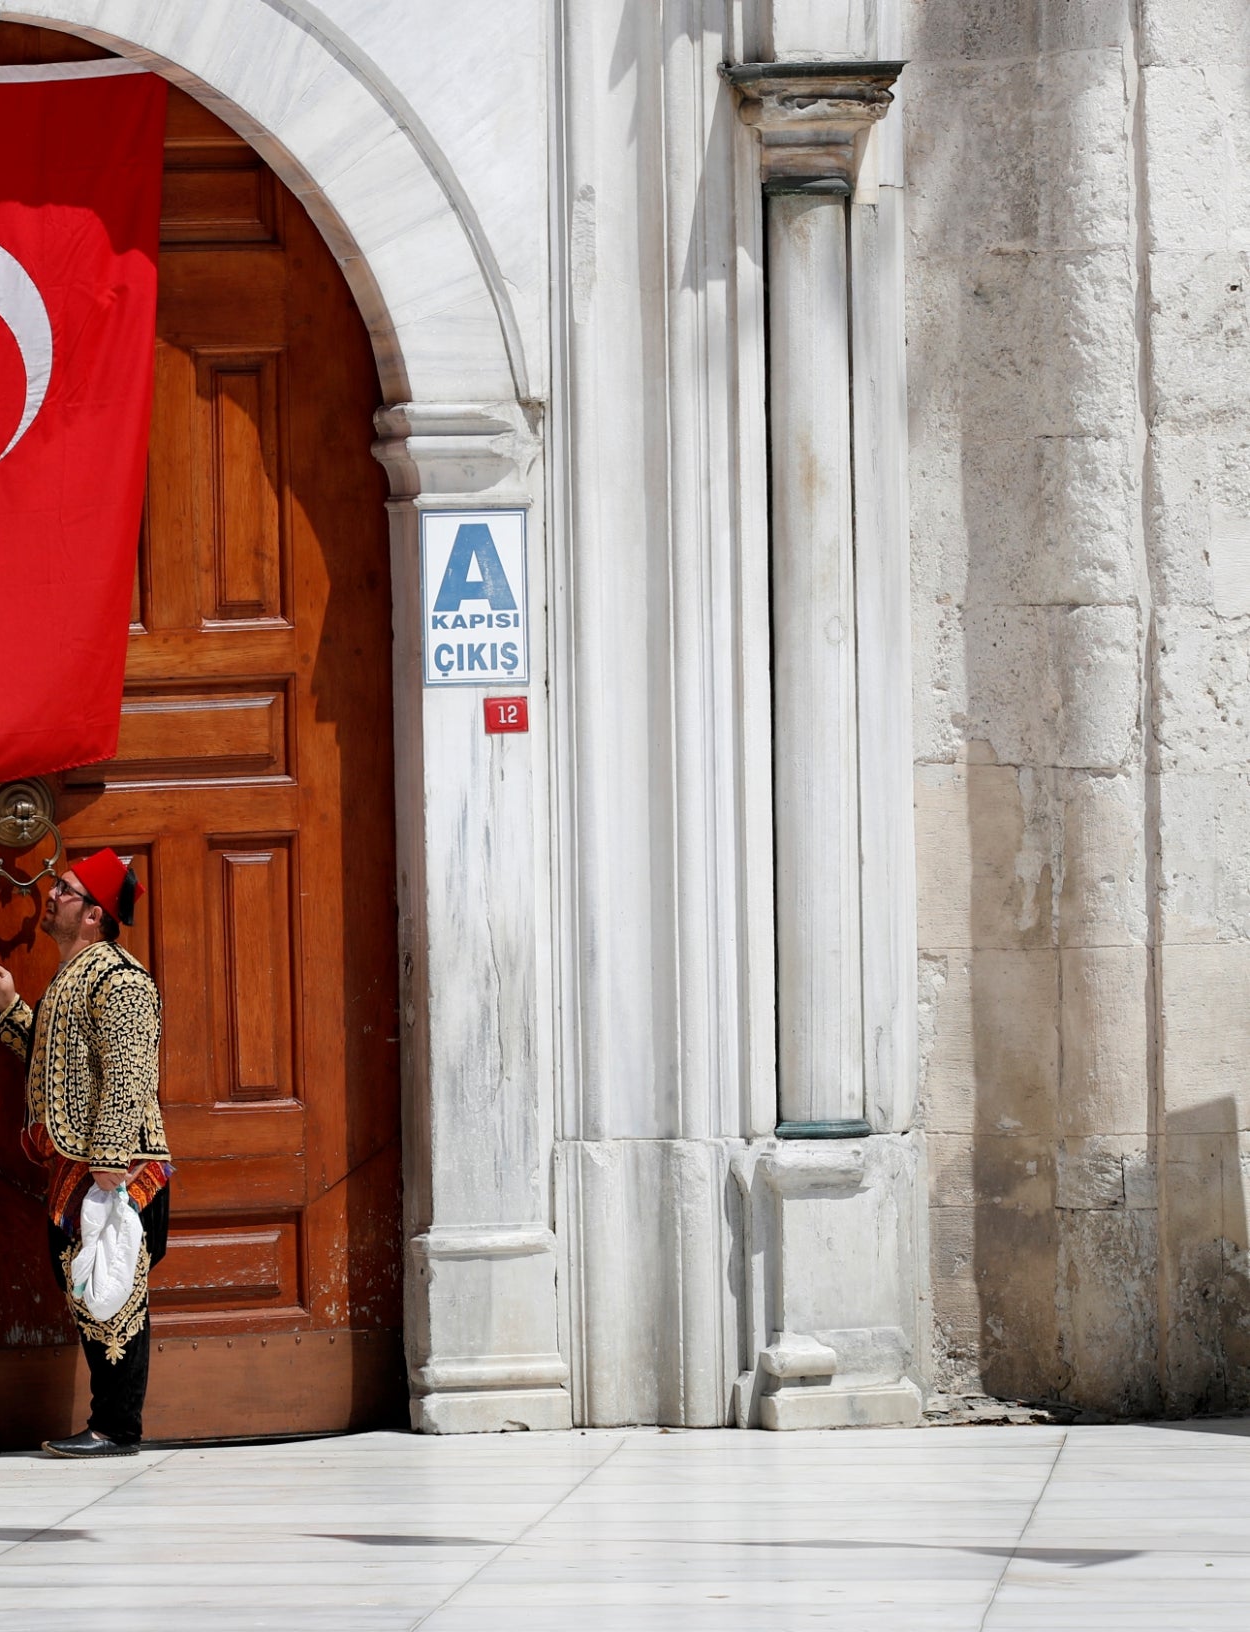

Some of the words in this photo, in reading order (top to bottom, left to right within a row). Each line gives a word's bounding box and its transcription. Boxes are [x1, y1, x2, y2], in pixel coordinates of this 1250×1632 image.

[433, 523, 518, 612] A
[431, 613, 519, 630] KAPISI
[434, 641, 519, 677] ÇIKIŞ
[497, 705, 518, 724] 12
